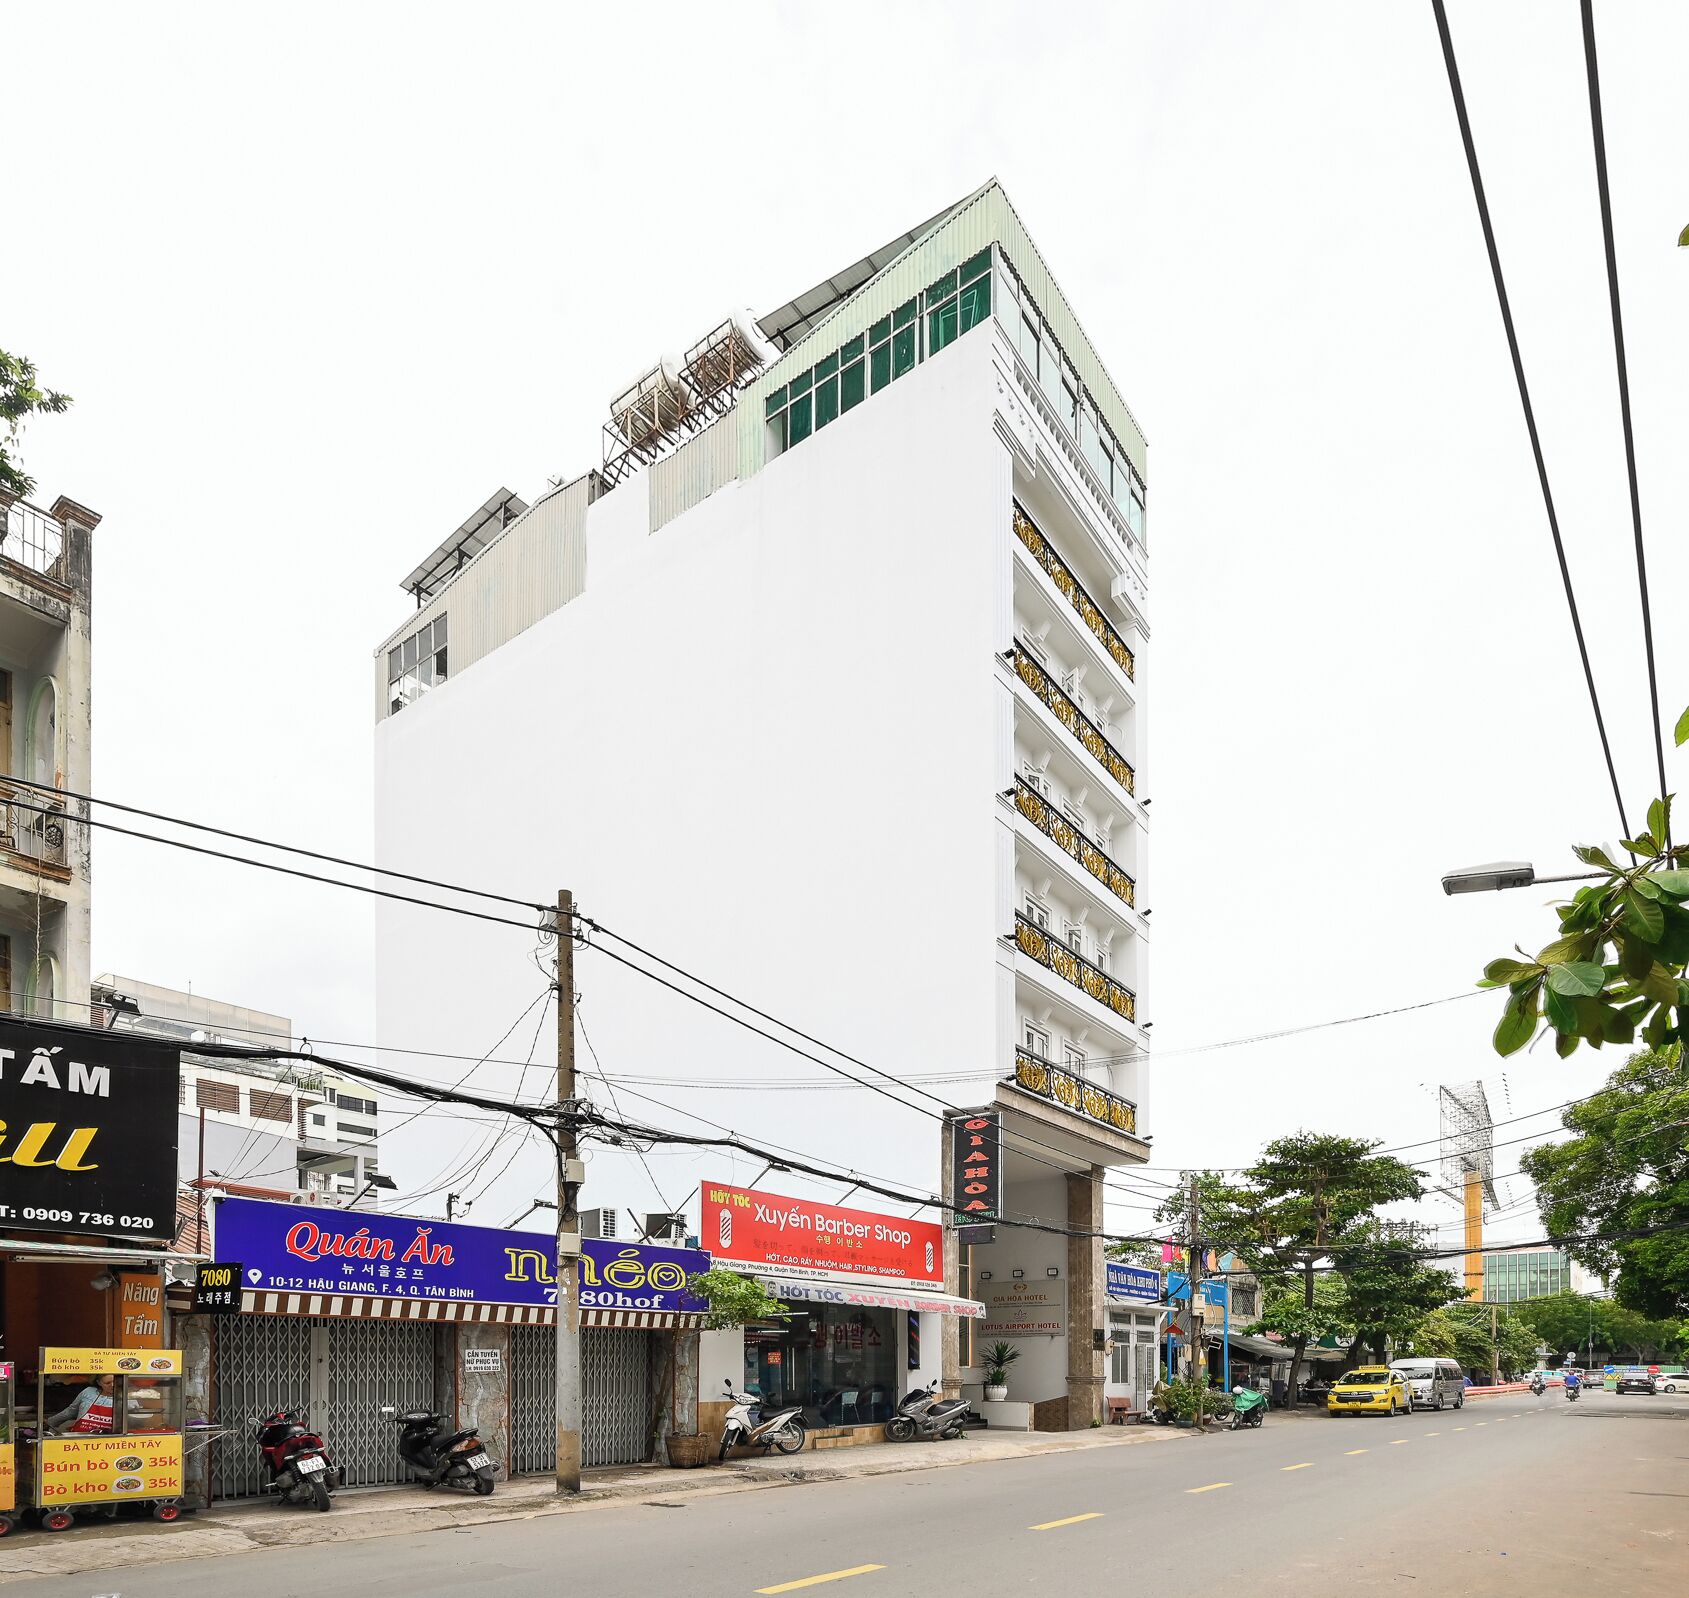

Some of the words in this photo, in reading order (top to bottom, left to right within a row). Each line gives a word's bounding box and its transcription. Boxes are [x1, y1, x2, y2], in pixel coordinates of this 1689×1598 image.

[23, 1207, 72, 1222] 0909
[79, 1212, 114, 1226] 736
[120, 1216, 154, 1229] 020
[754, 1202, 811, 1231] Xuyến
[815, 1213, 871, 1238] Barber
[874, 1224, 911, 1249] Shop
[286, 1222, 396, 1262] Quán
[401, 1227, 454, 1265] Ăn
[201, 1269, 231, 1287] 7080
[839, 1262, 853, 1270] HAIR
[879, 1267, 905, 1276] SHAMPOO
[123, 1282, 159, 1305] Nâng
[269, 1276, 303, 1288] 10-12
[308, 1278, 334, 1291] HẬU
[339, 1281, 378, 1293] GIANG,
[382, 1284, 392, 1293] F.
[396, 1285, 405, 1295] 4,
[410, 1285, 420, 1295] Q.
[424, 1286, 445, 1296] TÂN
[449, 1287, 474, 1298] BÌNH
[543, 1288, 664, 1309] 780hof
[953, 1304, 978, 1316] SHOP
[88, 1414, 112, 1423] Yaku
[63, 1442, 80, 1452] BÀ
[84, 1443, 101, 1451] TƯ
[105, 1440, 136, 1450] MIỀN
[140, 1440, 162, 1449] TÂY
[43, 1461, 80, 1473] Bún
[87, 1459, 109, 1471] bò
[149, 1456, 179, 1467] 35k
[43, 1484, 67, 1496] Bò
[73, 1482, 108, 1494] kho
[148, 1477, 178, 1489] 35k
